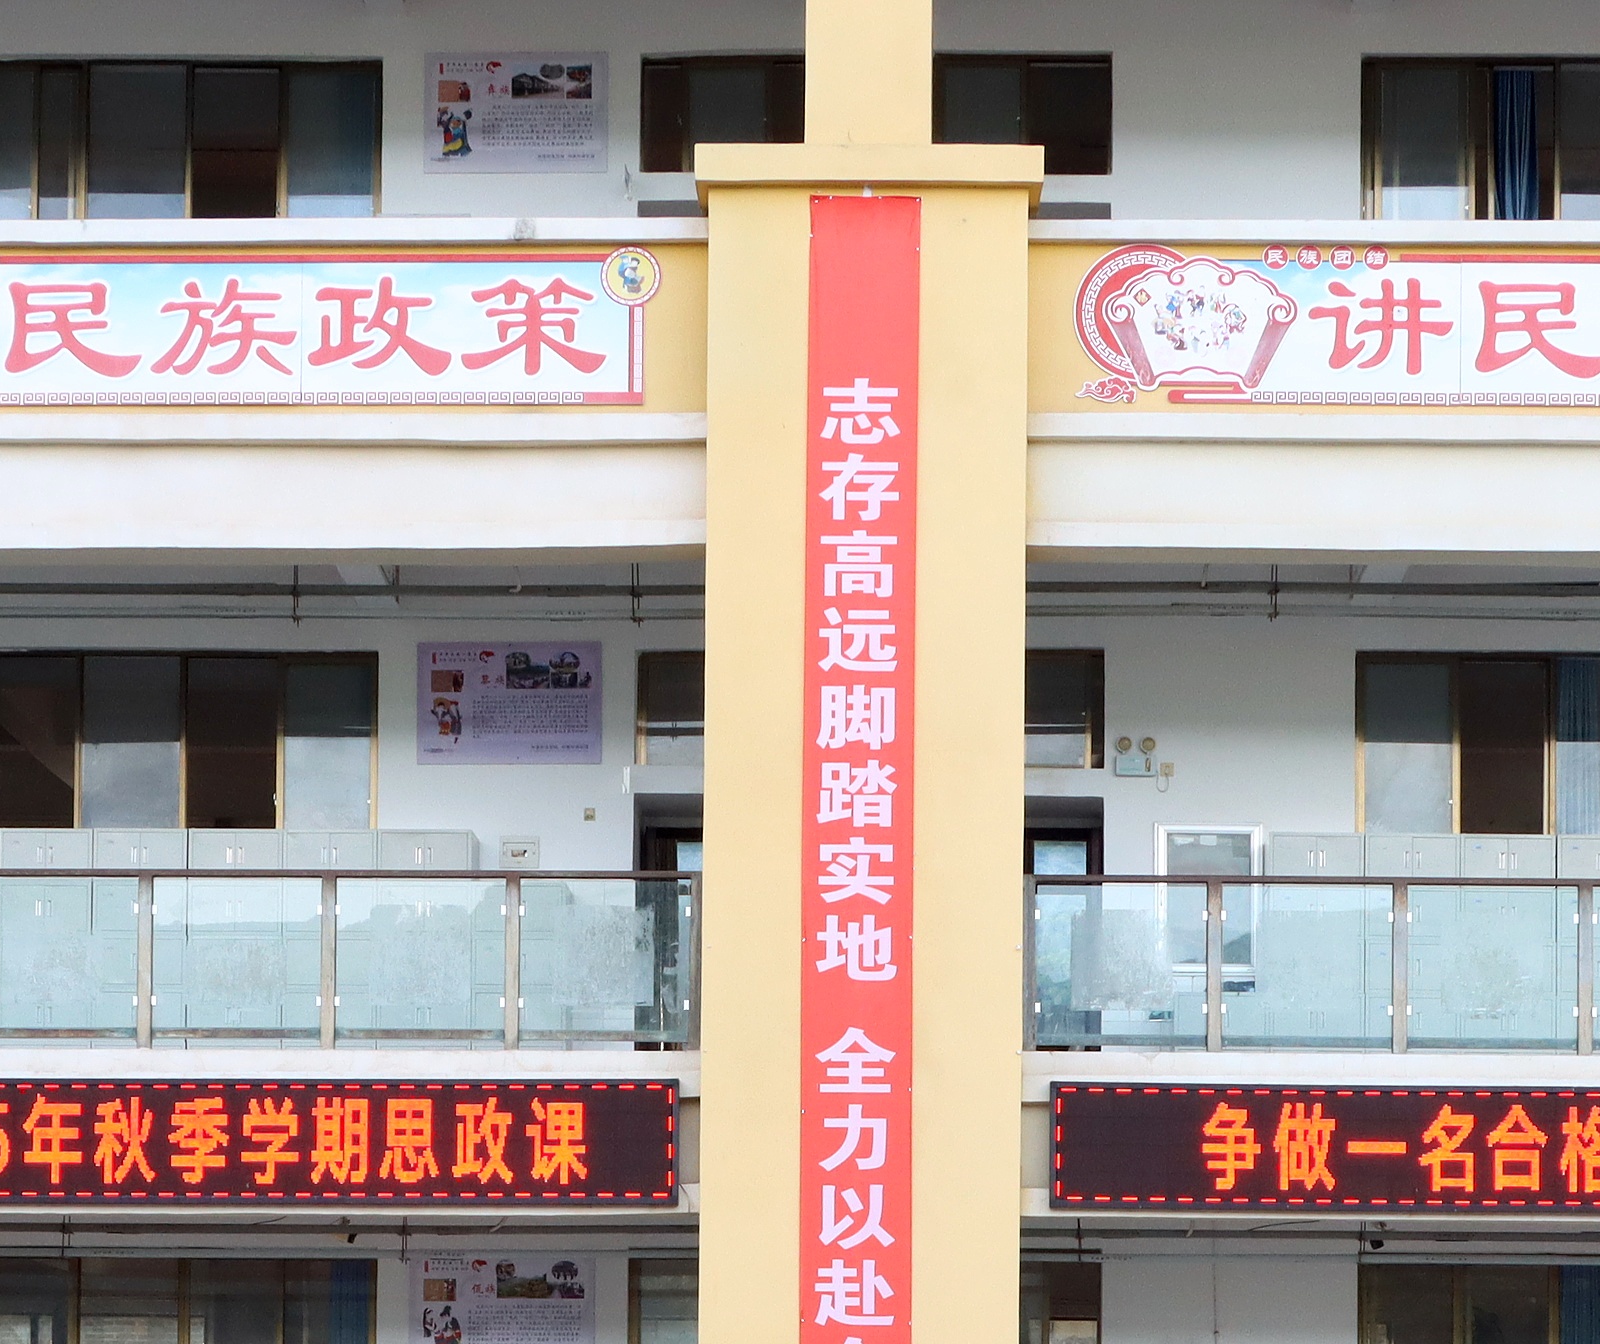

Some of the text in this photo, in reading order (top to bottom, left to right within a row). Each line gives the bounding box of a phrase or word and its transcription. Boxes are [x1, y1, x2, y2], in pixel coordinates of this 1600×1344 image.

[1266, 249, 1386, 266] 民族团结
[816, 377, 901, 982] 志存高远脚踏实地
